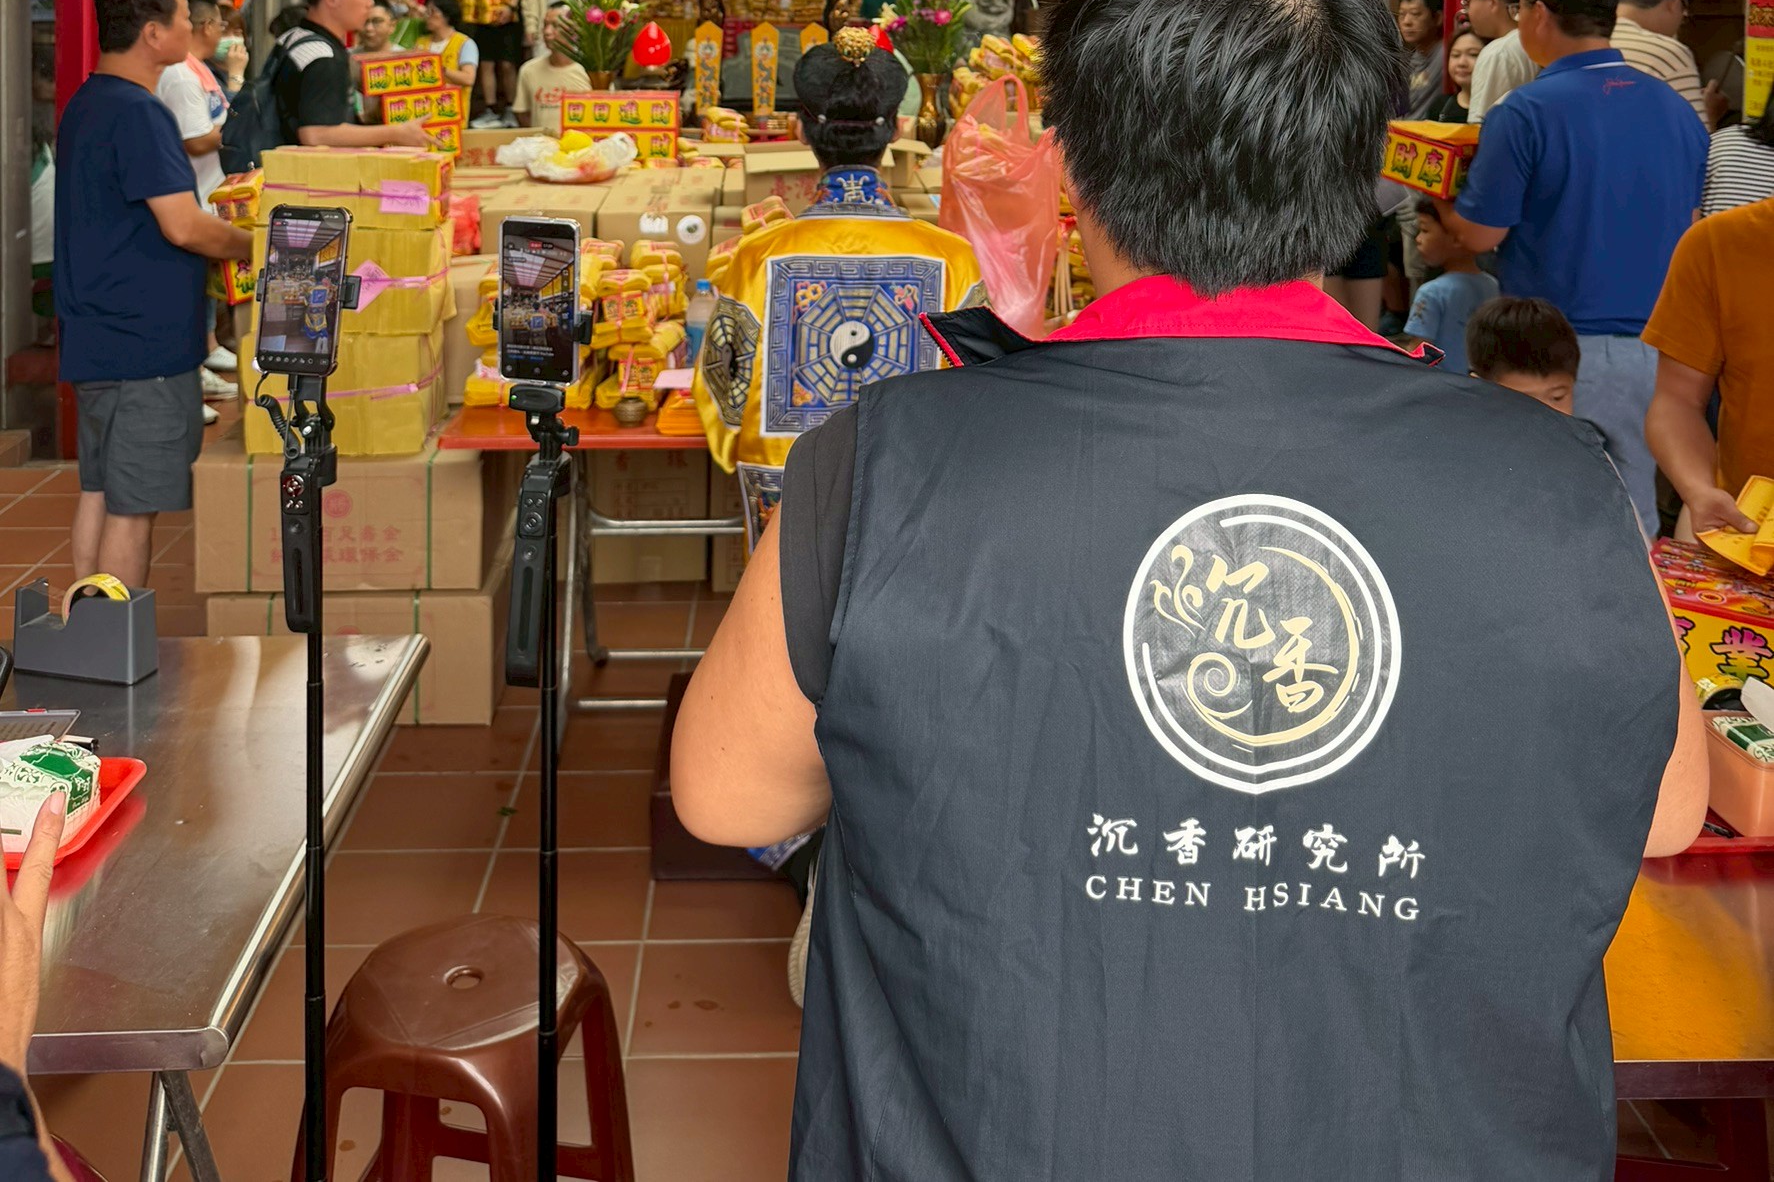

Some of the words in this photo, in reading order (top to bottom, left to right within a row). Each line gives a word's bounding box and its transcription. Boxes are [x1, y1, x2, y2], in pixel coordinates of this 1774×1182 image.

[1086, 813, 1426, 879] 沉香研究所
[1085, 874, 1212, 907] CHEN
[1243, 881, 1421, 921] HSIANG
